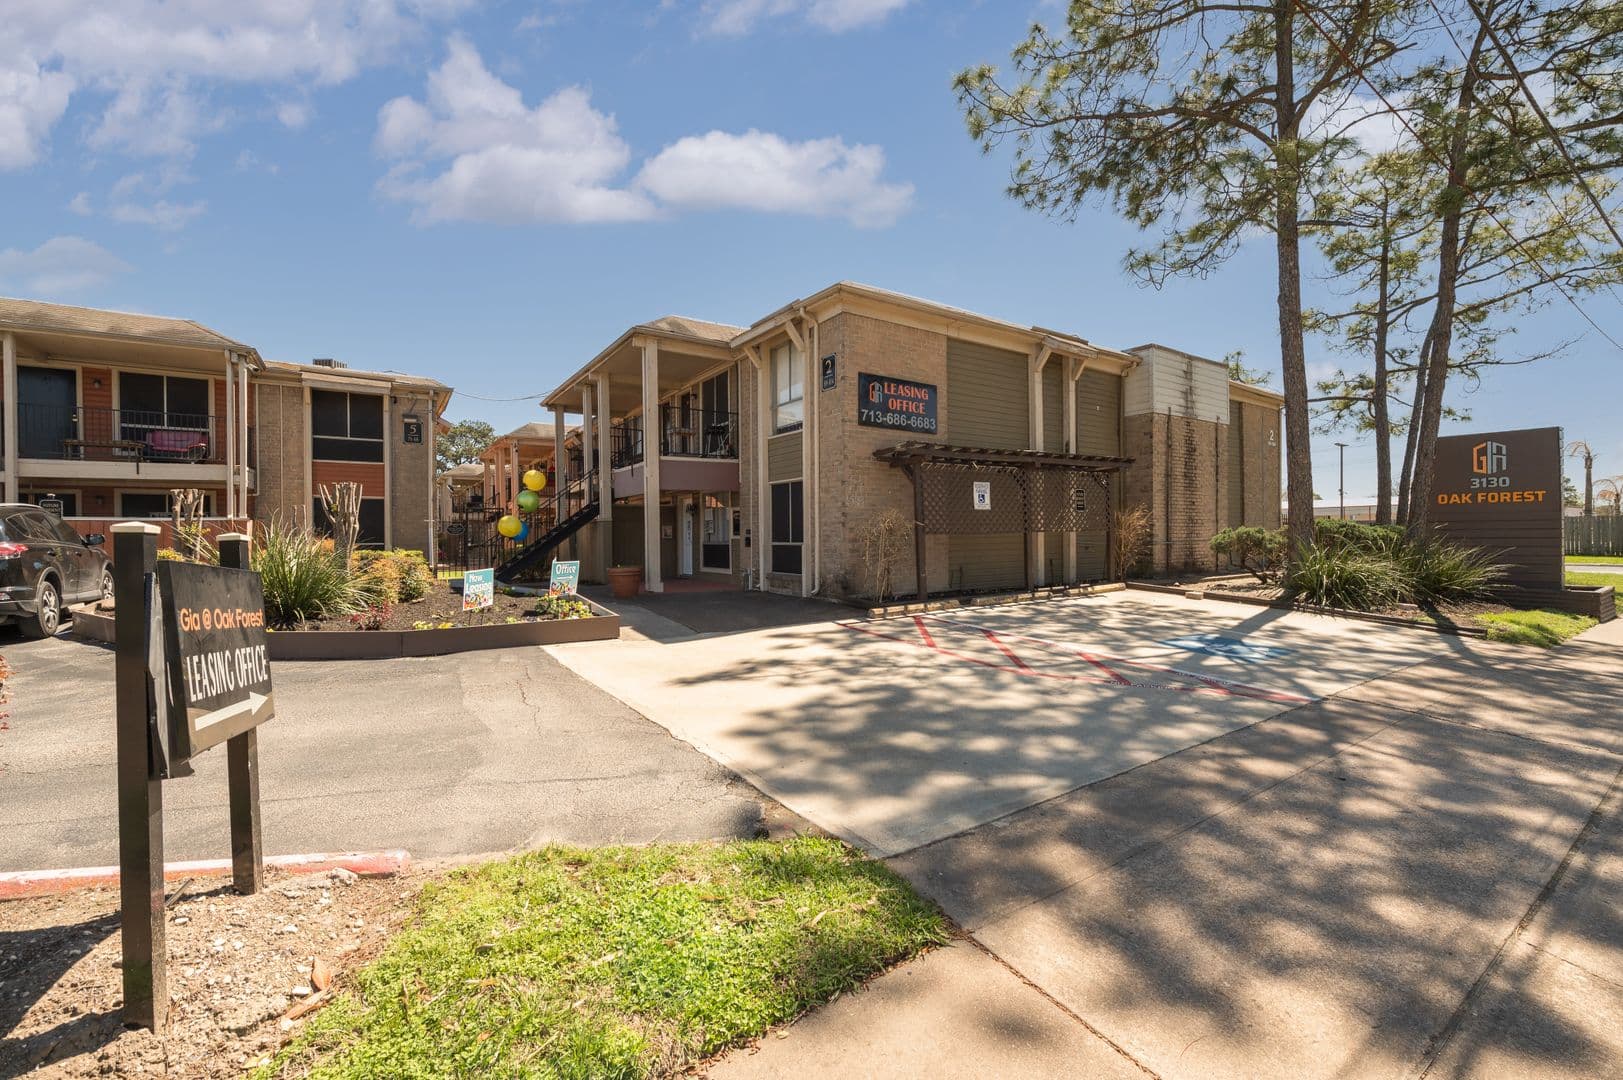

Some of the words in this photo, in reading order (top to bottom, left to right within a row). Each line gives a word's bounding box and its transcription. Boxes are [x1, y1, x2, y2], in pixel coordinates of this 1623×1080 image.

[825, 359, 833, 374] 2
[884, 382, 929, 400] LEASING
[888, 398, 926, 414] OFFICE
[861, 409, 936, 430] 713-686-6683
[409, 424, 417, 434] 5
[1269, 430, 1274, 441] 2
[1470, 476, 1510, 489] 3130
[1437, 492, 1473, 505] OAK
[1477, 490, 1547, 504] FOREST
[555, 564, 577, 575] Office
[180, 608, 201, 631] Gia
[202, 608, 212, 630] @
[213, 608, 235, 629] Oak
[236, 608, 264, 627] Forest
[186, 649, 234, 703] LEASING
[234, 645, 269, 688] OFFICE
